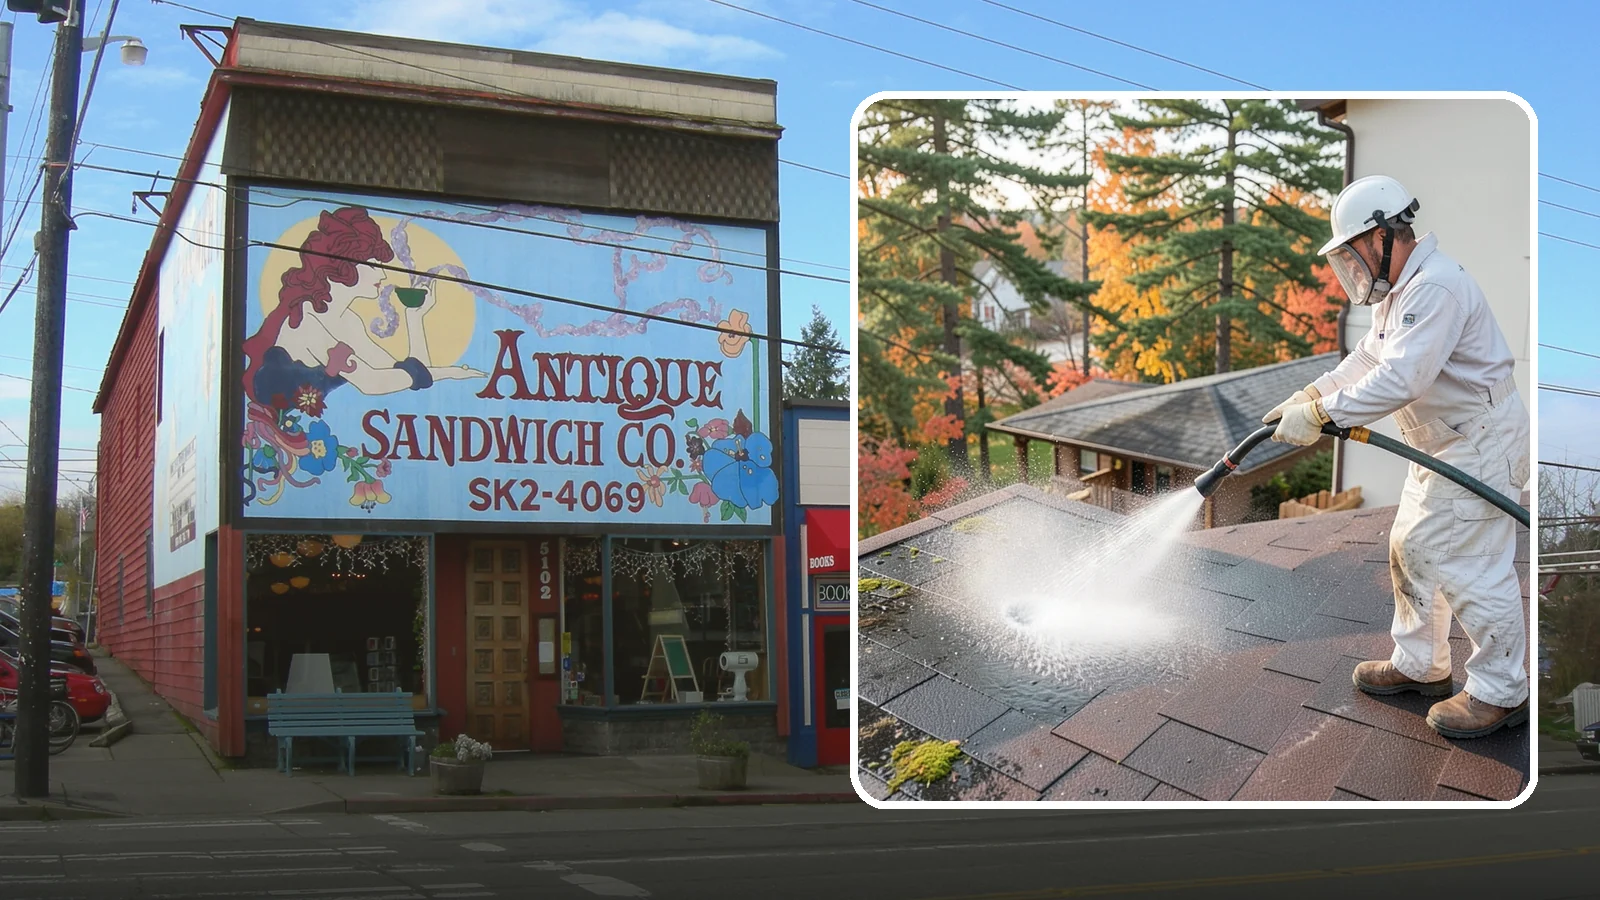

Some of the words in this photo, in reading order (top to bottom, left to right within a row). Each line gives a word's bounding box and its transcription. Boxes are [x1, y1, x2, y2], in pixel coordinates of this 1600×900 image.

[476, 328, 724, 421] ANTIQUE
[361, 408, 605, 468] SANDWICH
[617, 421, 685, 469] CO.
[468, 476, 646, 514] SK2-4069
[539, 541, 552, 600] 5102
[809, 555, 835, 569] BOOKS
